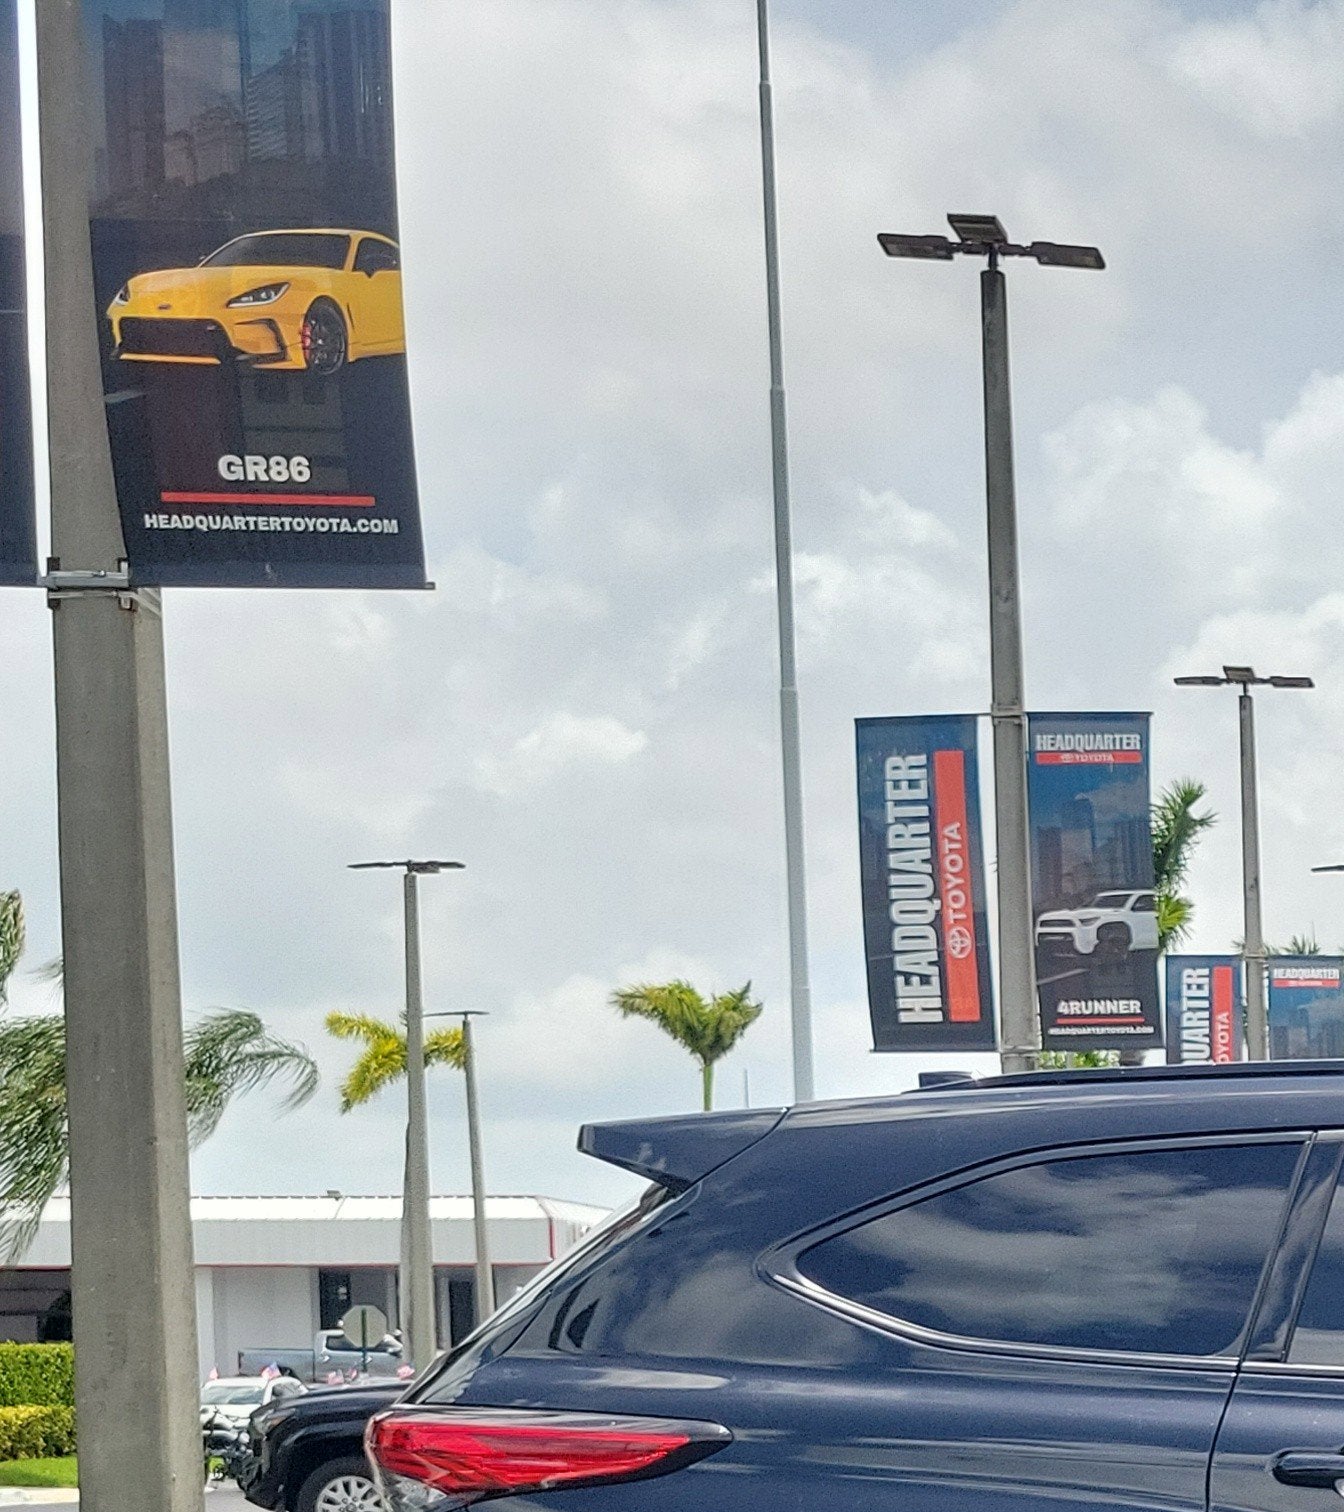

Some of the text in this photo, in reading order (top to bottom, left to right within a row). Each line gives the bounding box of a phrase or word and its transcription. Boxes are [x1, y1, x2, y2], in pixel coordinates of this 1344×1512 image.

[217, 454, 311, 483] GR86
[143, 513, 399, 534] HEADQUARTERTOYOTA.COM
[1036, 734, 1141, 753] HEADQUARTER
[943, 821, 968, 925] TOYOTA
[885, 753, 944, 1023] HEADQUARTER
[1057, 1000, 1142, 1015] 4RUNNER
[1180, 967, 1212, 1064] UARTER
